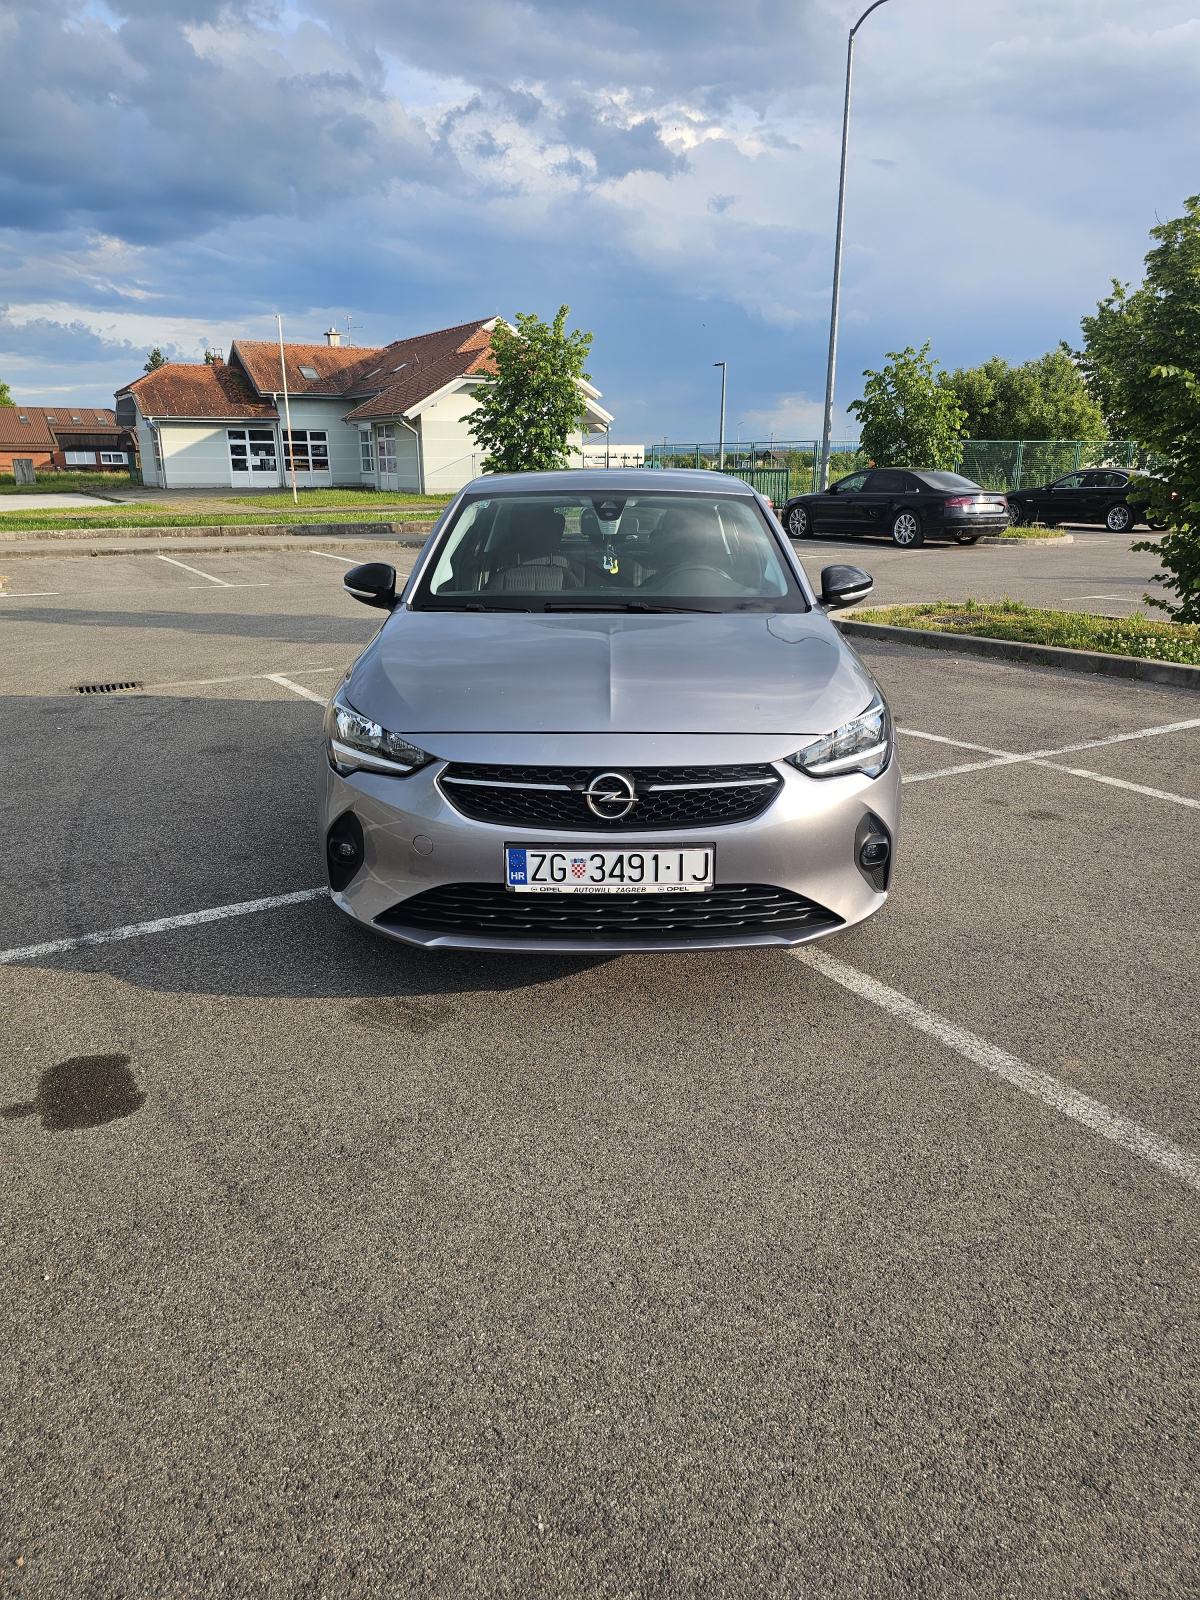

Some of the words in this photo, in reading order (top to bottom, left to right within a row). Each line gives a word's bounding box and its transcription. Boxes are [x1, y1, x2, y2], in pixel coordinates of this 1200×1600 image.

[530, 853, 567, 882] ZG
[510, 872, 525, 881] HR
[573, 886, 612, 894] AUTOWILL
